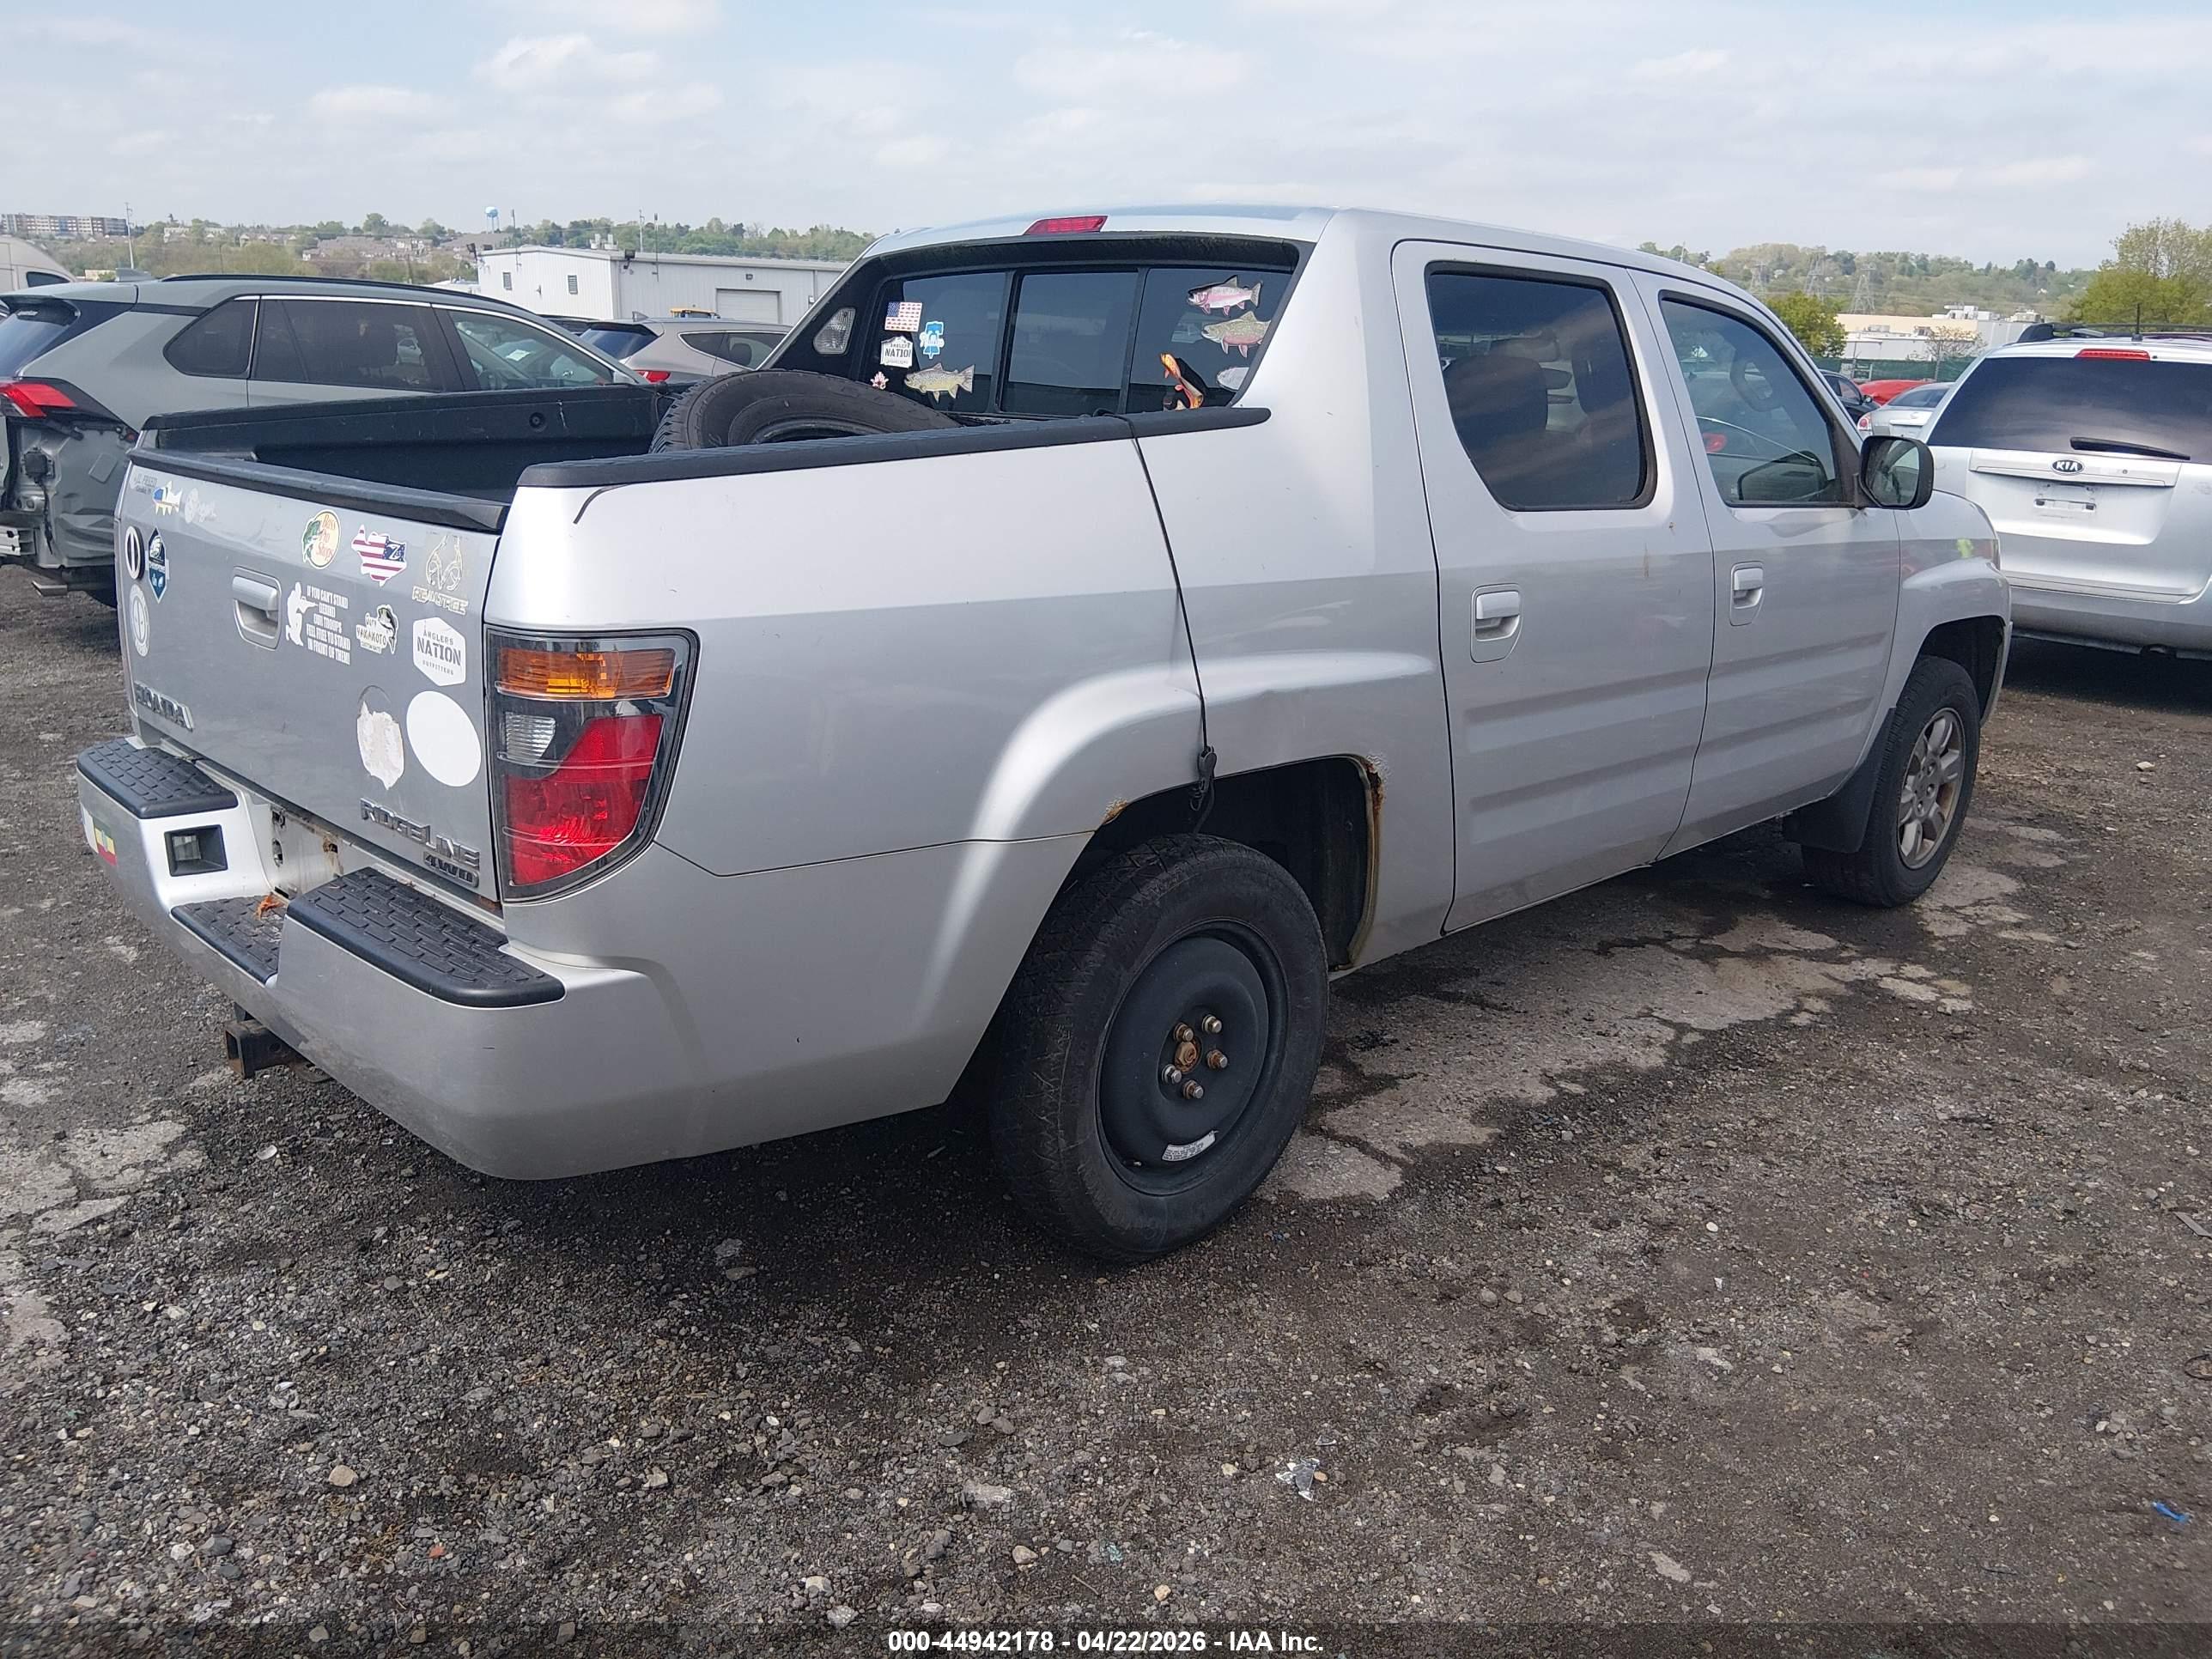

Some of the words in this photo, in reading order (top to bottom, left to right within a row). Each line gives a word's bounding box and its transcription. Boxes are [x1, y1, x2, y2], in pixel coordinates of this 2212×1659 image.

[2057, 461, 2078, 471] KIA
[312, 586, 320, 600] YOU
[320, 589, 333, 605] CAN'T
[333, 593, 349, 610] STAND
[307, 623, 316, 638] FEEL
[316, 627, 328, 642] FREE
[327, 630, 334, 645] TO
[334, 634, 351, 651] STAND
[313, 639, 328, 657] FRONT
[328, 645, 335, 659] OF
[423, 628, 454, 646] ANGLERS
[417, 635, 461, 666] NATION
[359, 797, 481, 870] RIDGELINE
